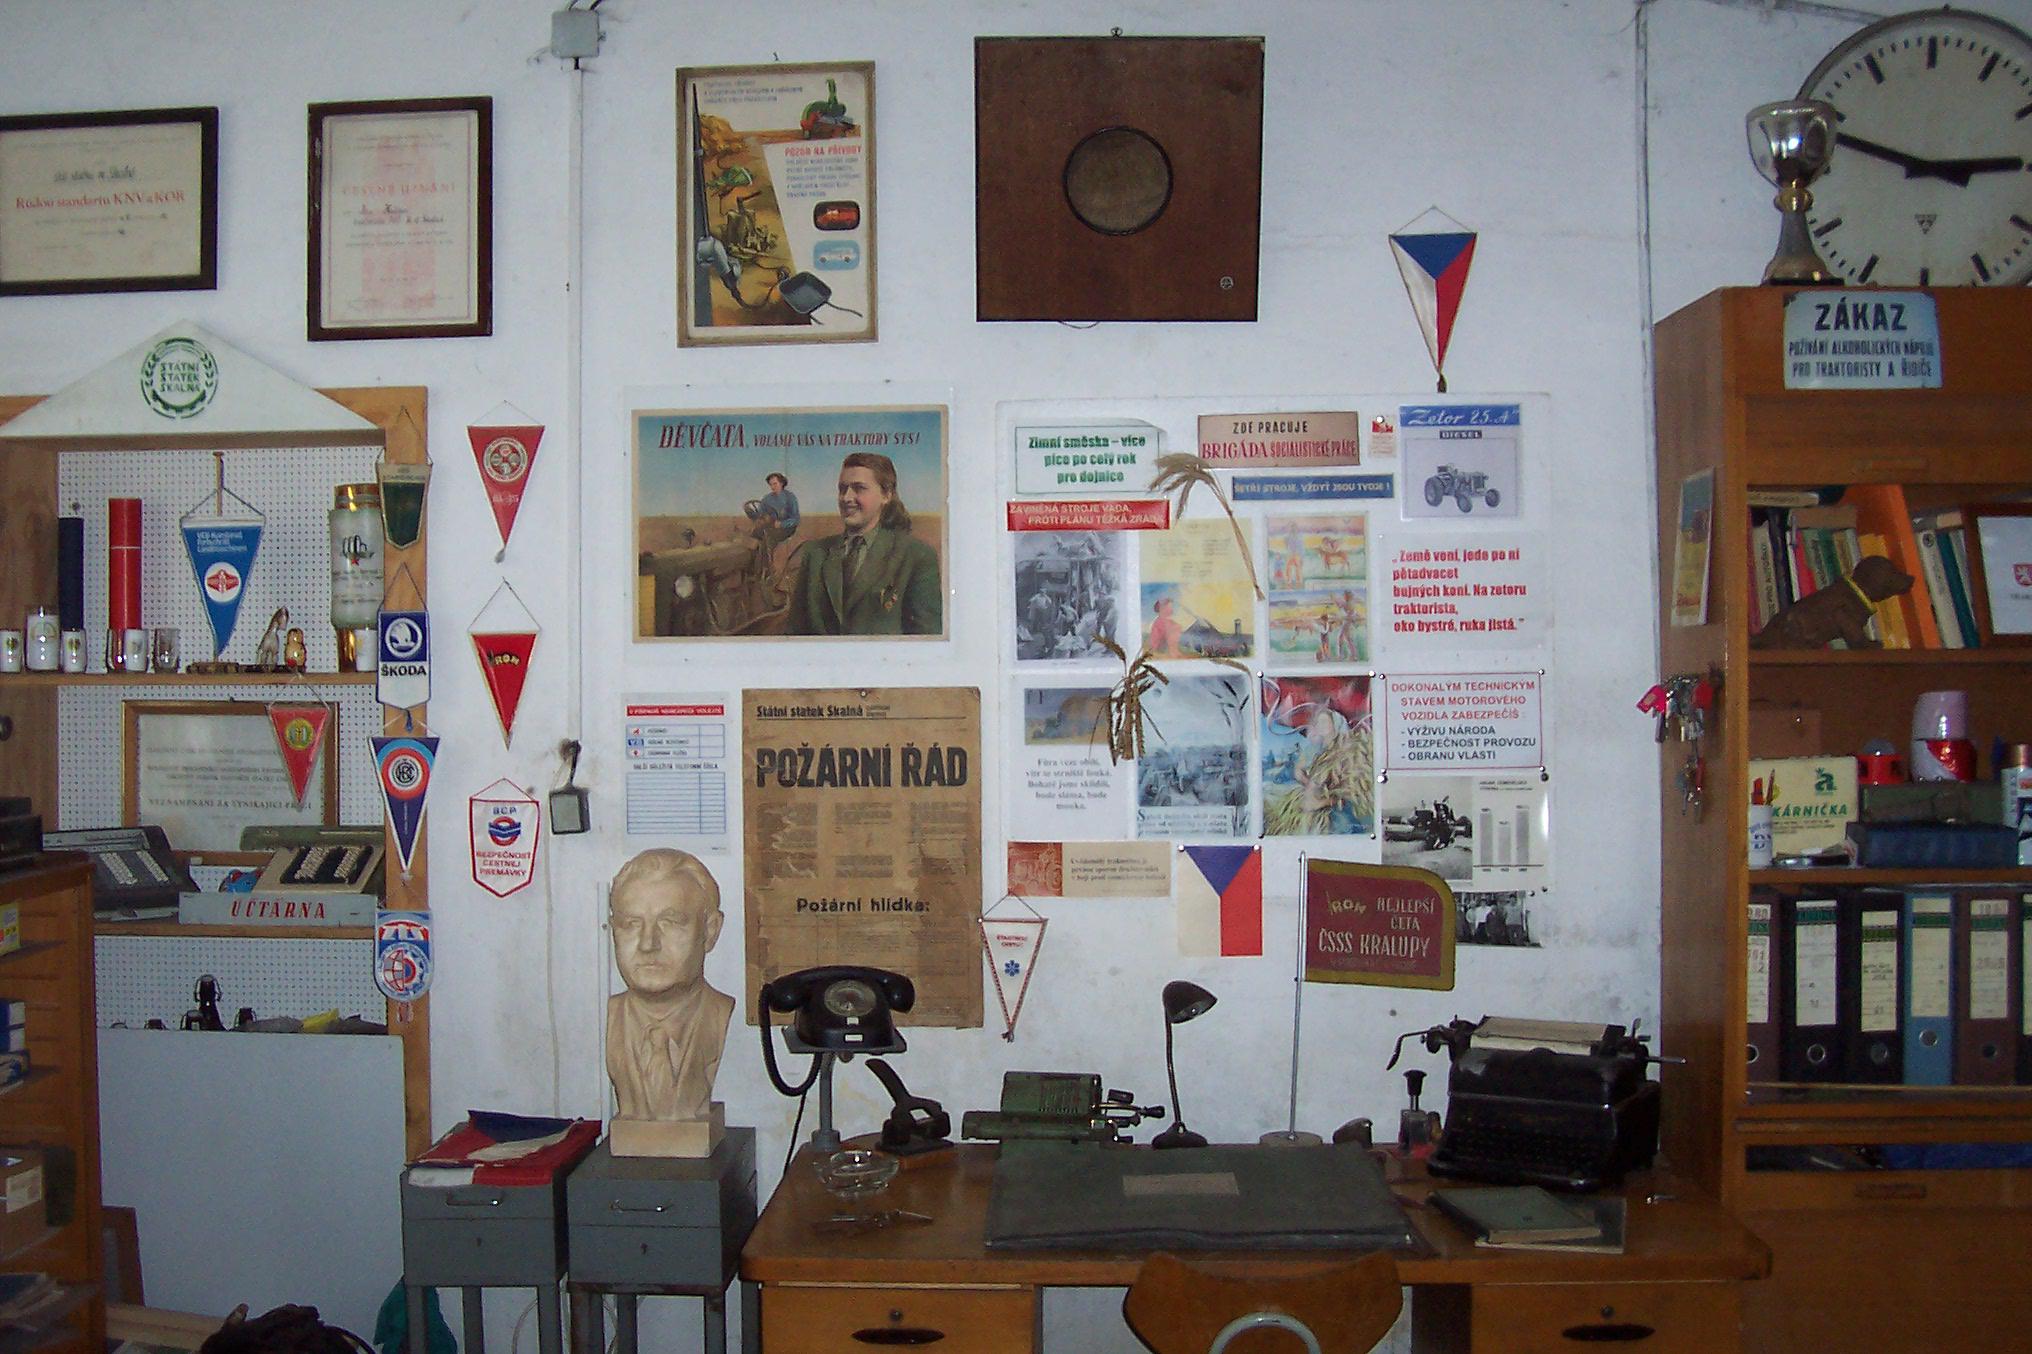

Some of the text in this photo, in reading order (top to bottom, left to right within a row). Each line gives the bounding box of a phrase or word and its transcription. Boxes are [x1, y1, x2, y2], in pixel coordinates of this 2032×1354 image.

[1815, 296, 1907, 331] ZÁKAZ
[1792, 361, 1811, 377] PRO
[1816, 361, 1881, 377] TRAKTORISTY
[1888, 361, 1895, 376] A
[1232, 420, 1308, 434] ZDE PRACUJE
[658, 421, 745, 449] DĚVČATA
[1029, 436, 1061, 449] Zimní
[1063, 436, 1109, 449] směska
[1121, 434, 1146, 447] více
[1441, 431, 1481, 439] DIESEL
[1202, 437, 1268, 460] BRIGÁDA
[1073, 455, 1087, 467] po
[1090, 453, 1113, 467] celý
[1117, 452, 1136, 465] rok
[1057, 470, 1124, 485] pro dojnice
[1028, 515, 1058, 525] PROTI
[1463, 549, 1488, 563] jede
[1491, 550, 1506, 562] po
[1392, 567, 1458, 581] pětadvacet
[1393, 584, 1440, 598] bujných
[1473, 584, 1488, 596] Na
[1490, 584, 1526, 596] zetoru
[1394, 620, 1415, 632] oko
[1460, 619, 1485, 631] ruka
[381, 664, 427, 677] ŠKODA
[1465, 680, 1535, 692] TECHNICKÝM
[1401, 694, 1526, 706] STAVEM MOTOROVÉHO
[756, 705, 788, 718] Státní
[790, 705, 824, 718] statek
[827, 704, 863, 718] Skalná
[1402, 707, 1519, 721] VOZIDLA ZABEZPEČÍŠ
[1407, 725, 1445, 736] VÝŽIVU
[1449, 724, 1496, 735] NÁRODA
[1408, 737, 1480, 748] BEZPEČNOST
[1484, 737, 1536, 748] PROVOZU
[1408, 750, 1455, 761] OBRANU
[1458, 750, 1496, 760] VLASTI
[756, 742, 968, 788] POŽÁRNÍ ŘÁD
[1772, 802, 1848, 817] KÁRNIČKA
[796, 897, 930, 913] Požární hlídka:
[1319, 928, 1430, 958] ČSSS KRALUPY
